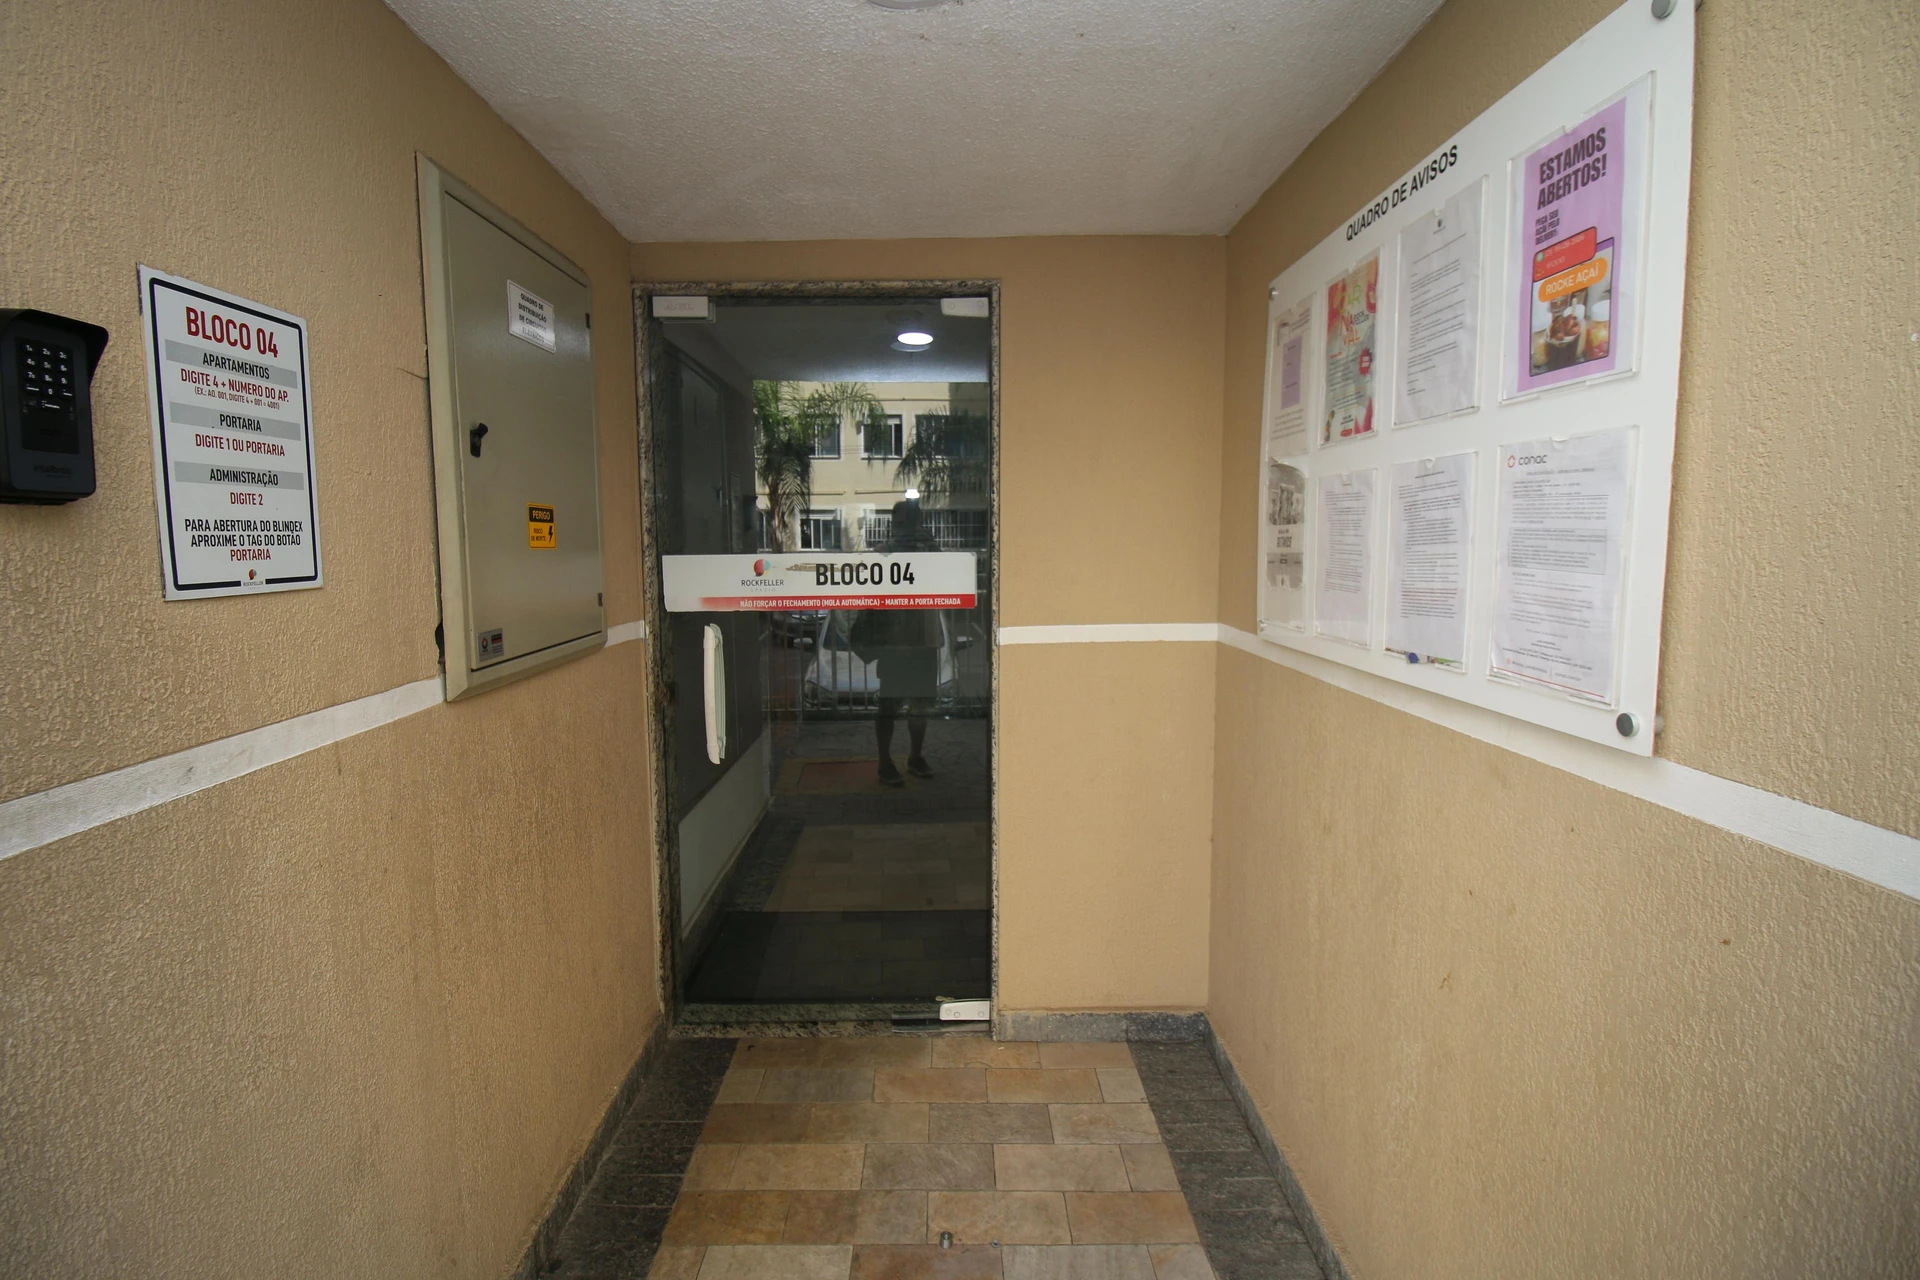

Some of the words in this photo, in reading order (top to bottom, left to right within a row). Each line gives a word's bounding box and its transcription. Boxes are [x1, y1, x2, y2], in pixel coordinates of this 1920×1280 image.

[1539, 126, 1607, 185] ESTAMOS
[1537, 153, 1608, 211] ABERTOS!
[1346, 196, 1389, 241] QUADRO
[1391, 181, 1408, 209] DE
[1409, 144, 1458, 197] AVISOS
[1545, 275, 1574, 295] ROCKE
[520, 294, 538, 308] QUADRO
[538, 303, 544, 311] DE
[186, 306, 252, 351] BLOCO
[256, 327, 278, 358] 04
[202, 352, 270, 380] APARTAMENTOS
[181, 368, 211, 387] DIGITE
[212, 375, 219, 389] 4
[228, 378, 263, 398] NUMERO
[264, 386, 276, 400] DO
[277, 389, 290, 403] AP.
[229, 393, 245, 404] DIGITE
[219, 413, 262, 433] PORTARIA
[195, 433, 225, 450] DIGITE
[226, 438, 231, 450] 1
[232, 438, 244, 452] OU
[245, 440, 286, 457] PORTARIA
[209, 468, 279, 488] ADMINISTRAÇÃO
[230, 492, 257, 506] DIGITE
[258, 494, 264, 506] 2
[532, 510, 550, 520] PERIGO
[184, 519, 211, 532] PARA
[213, 519, 258, 533] ABERTURA
[260, 520, 271, 532] DO
[272, 520, 304, 533] BLINDEX
[191, 534, 237, 548] APROXIME
[239, 535, 246, 547] O
[247, 535, 263, 547] TAG
[264, 534, 276, 547] DO
[277, 531, 301, 546] BOTÃO
[230, 548, 272, 562] PORTARIA
[741, 579, 784, 587] ROCKFELLER
[815, 563, 883, 587] BLOCO
[890, 562, 915, 586] 04
[740, 599, 753, 608] NÃO
[753, 600, 777, 609] FORÇAR
[783, 599, 821, 607] FECHAMENTO
[821, 599, 841, 607] (MOLA
[841, 597, 880, 607] AUTOMÁTICA)
[885, 598, 909, 606] MANTER
[909, 598, 914, 606] A
[914, 598, 934, 606] PORTA
[934, 598, 961, 606] FECHADA
